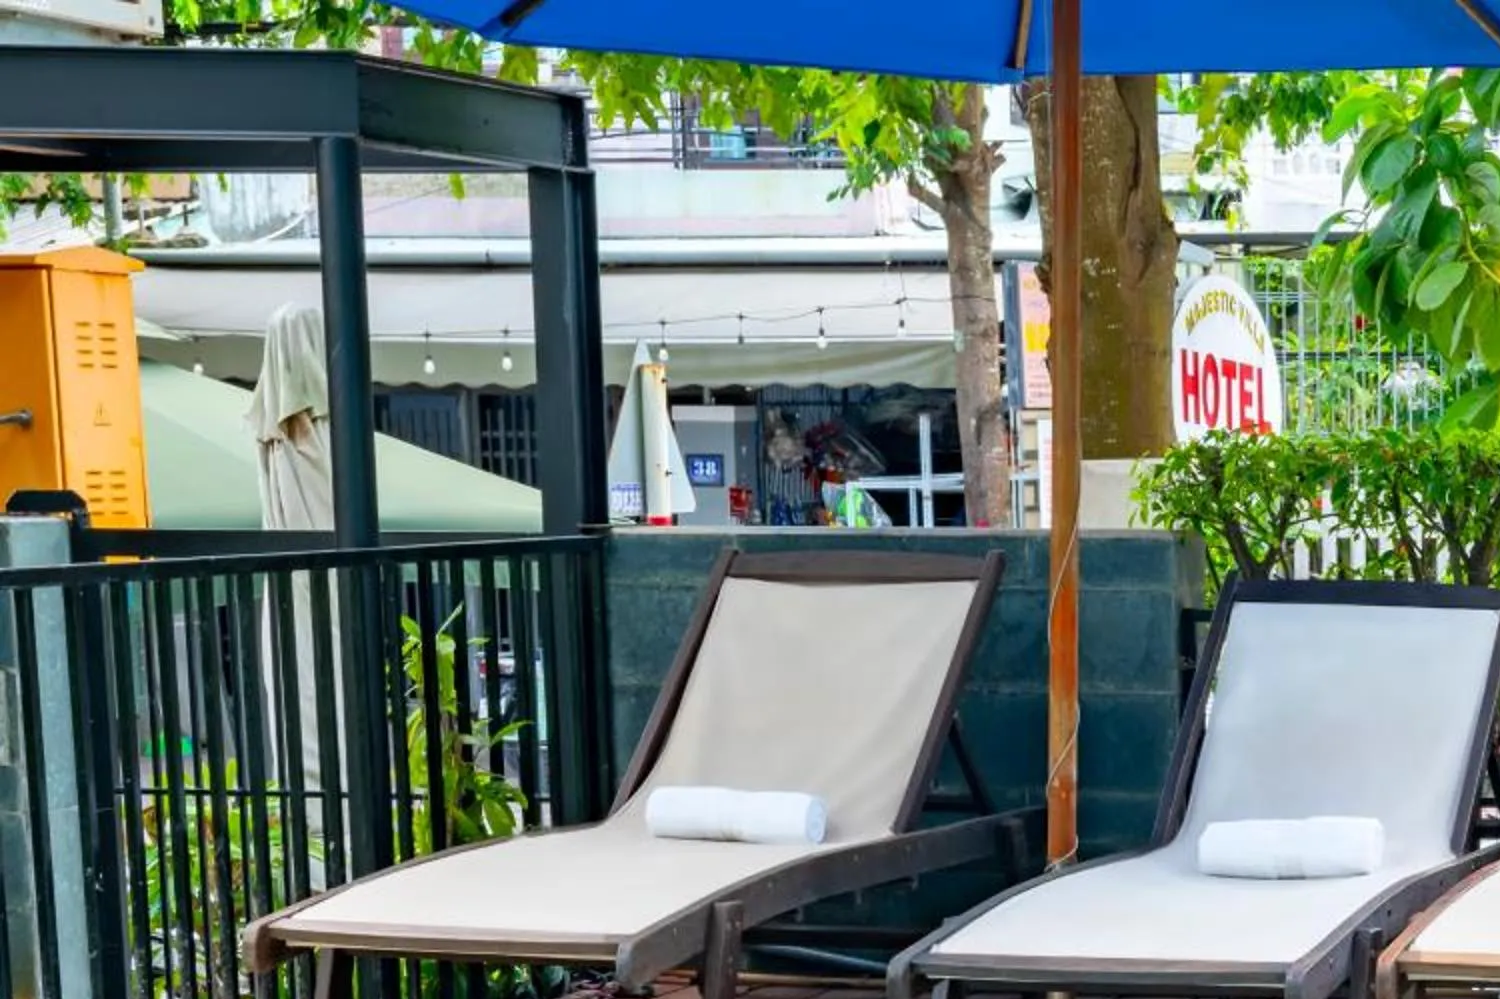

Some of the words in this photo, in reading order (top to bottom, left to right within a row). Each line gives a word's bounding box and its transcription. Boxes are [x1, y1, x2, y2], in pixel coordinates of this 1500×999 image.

[1184, 289, 1236, 336] MAJESTIC
[1181, 348, 1272, 435] HOTEL
[692, 460, 717, 476] 38
